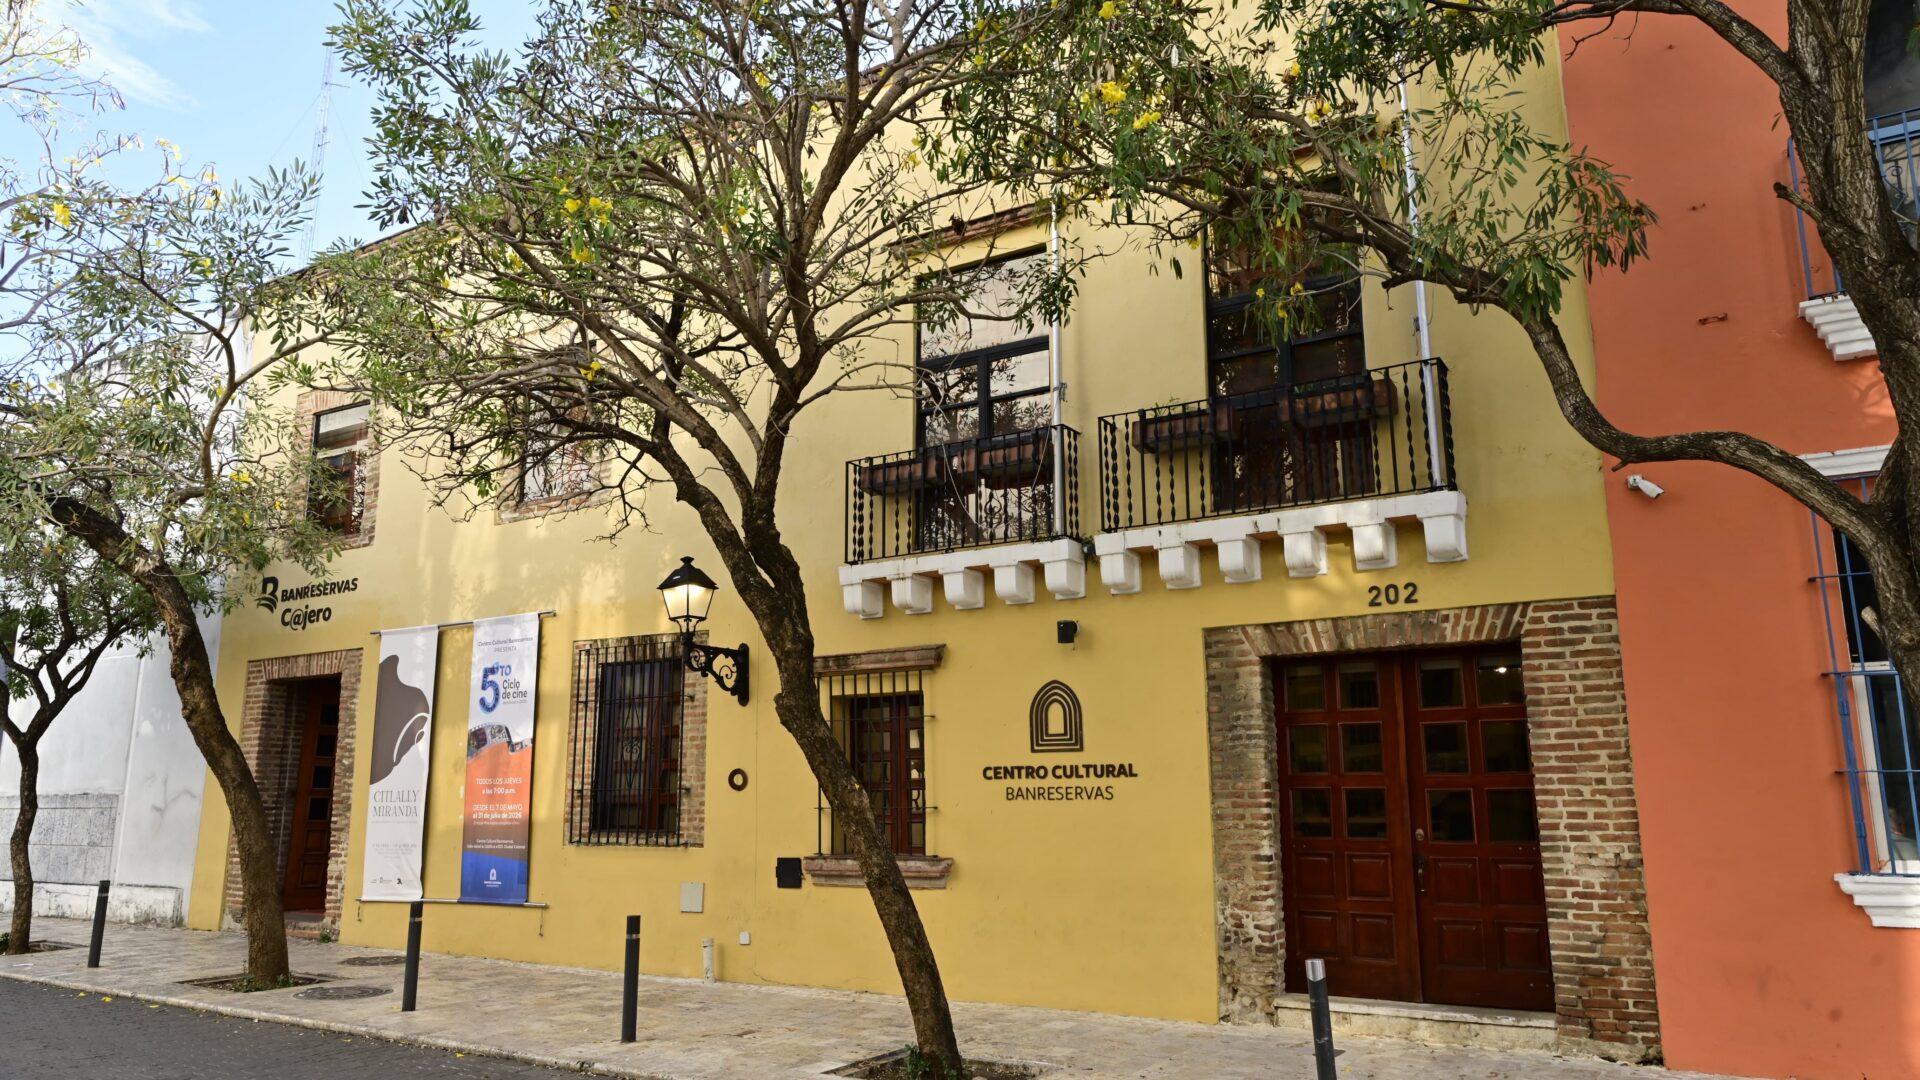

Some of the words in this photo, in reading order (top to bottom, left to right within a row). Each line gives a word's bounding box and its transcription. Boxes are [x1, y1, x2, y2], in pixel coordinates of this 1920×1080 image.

[280, 577, 359, 602] BANRESERVAS
[1368, 582, 1418, 607] 202
[281, 604, 332, 631] C@jero
[502, 678, 520, 690] Ciclo
[502, 689, 511, 699] de
[512, 689, 528, 699] cine
[983, 765, 1049, 780] CENTRO
[1051, 763, 1138, 780] CULTURAL
[373, 790, 419, 803] CITLALLY
[1005, 786, 1114, 801] BANRESERVAS
[372, 806, 418, 817] MIRANDA
[507, 803, 522, 811] MAYO
